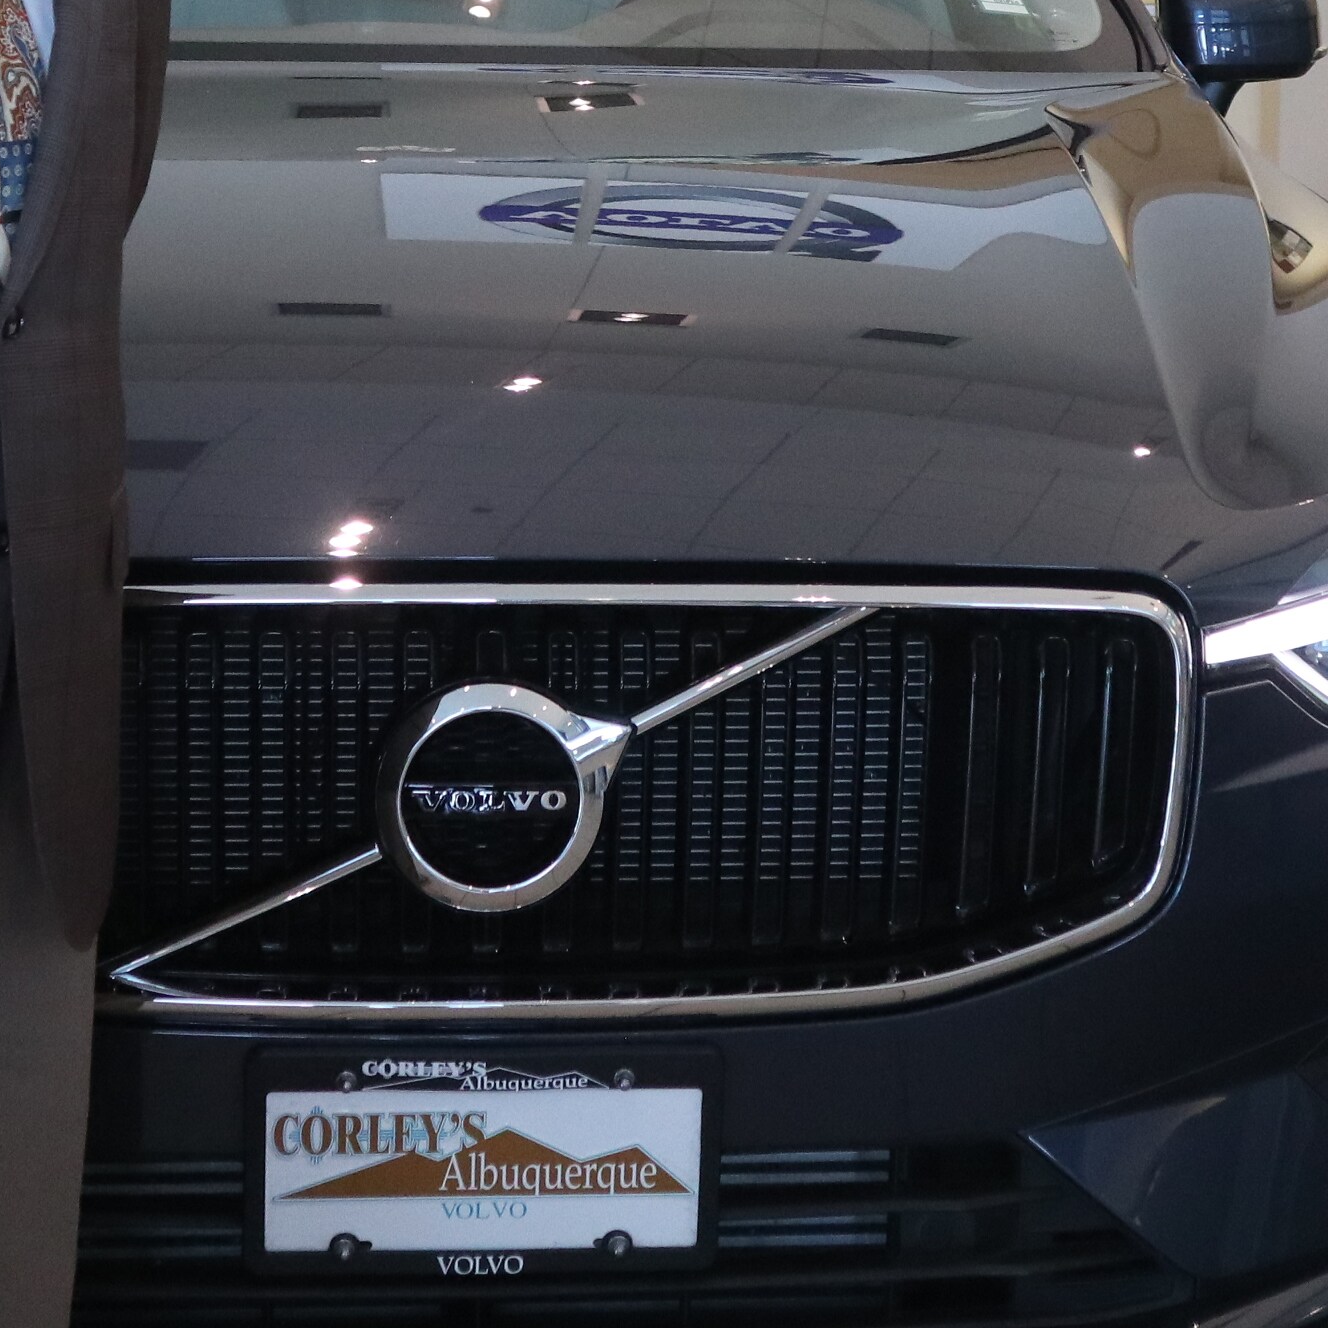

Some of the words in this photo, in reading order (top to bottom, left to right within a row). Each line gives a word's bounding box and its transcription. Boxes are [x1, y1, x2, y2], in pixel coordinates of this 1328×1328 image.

[412, 789, 567, 811] VOLVO
[361, 1059, 488, 1079] CORLEY'S
[460, 1074, 589, 1092] Albuquerque
[272, 1111, 487, 1156] CORLEY'S
[438, 1151, 657, 1196] Albuquerque
[441, 1201, 528, 1220] VOLVO
[437, 1255, 524, 1276] VOLVO
